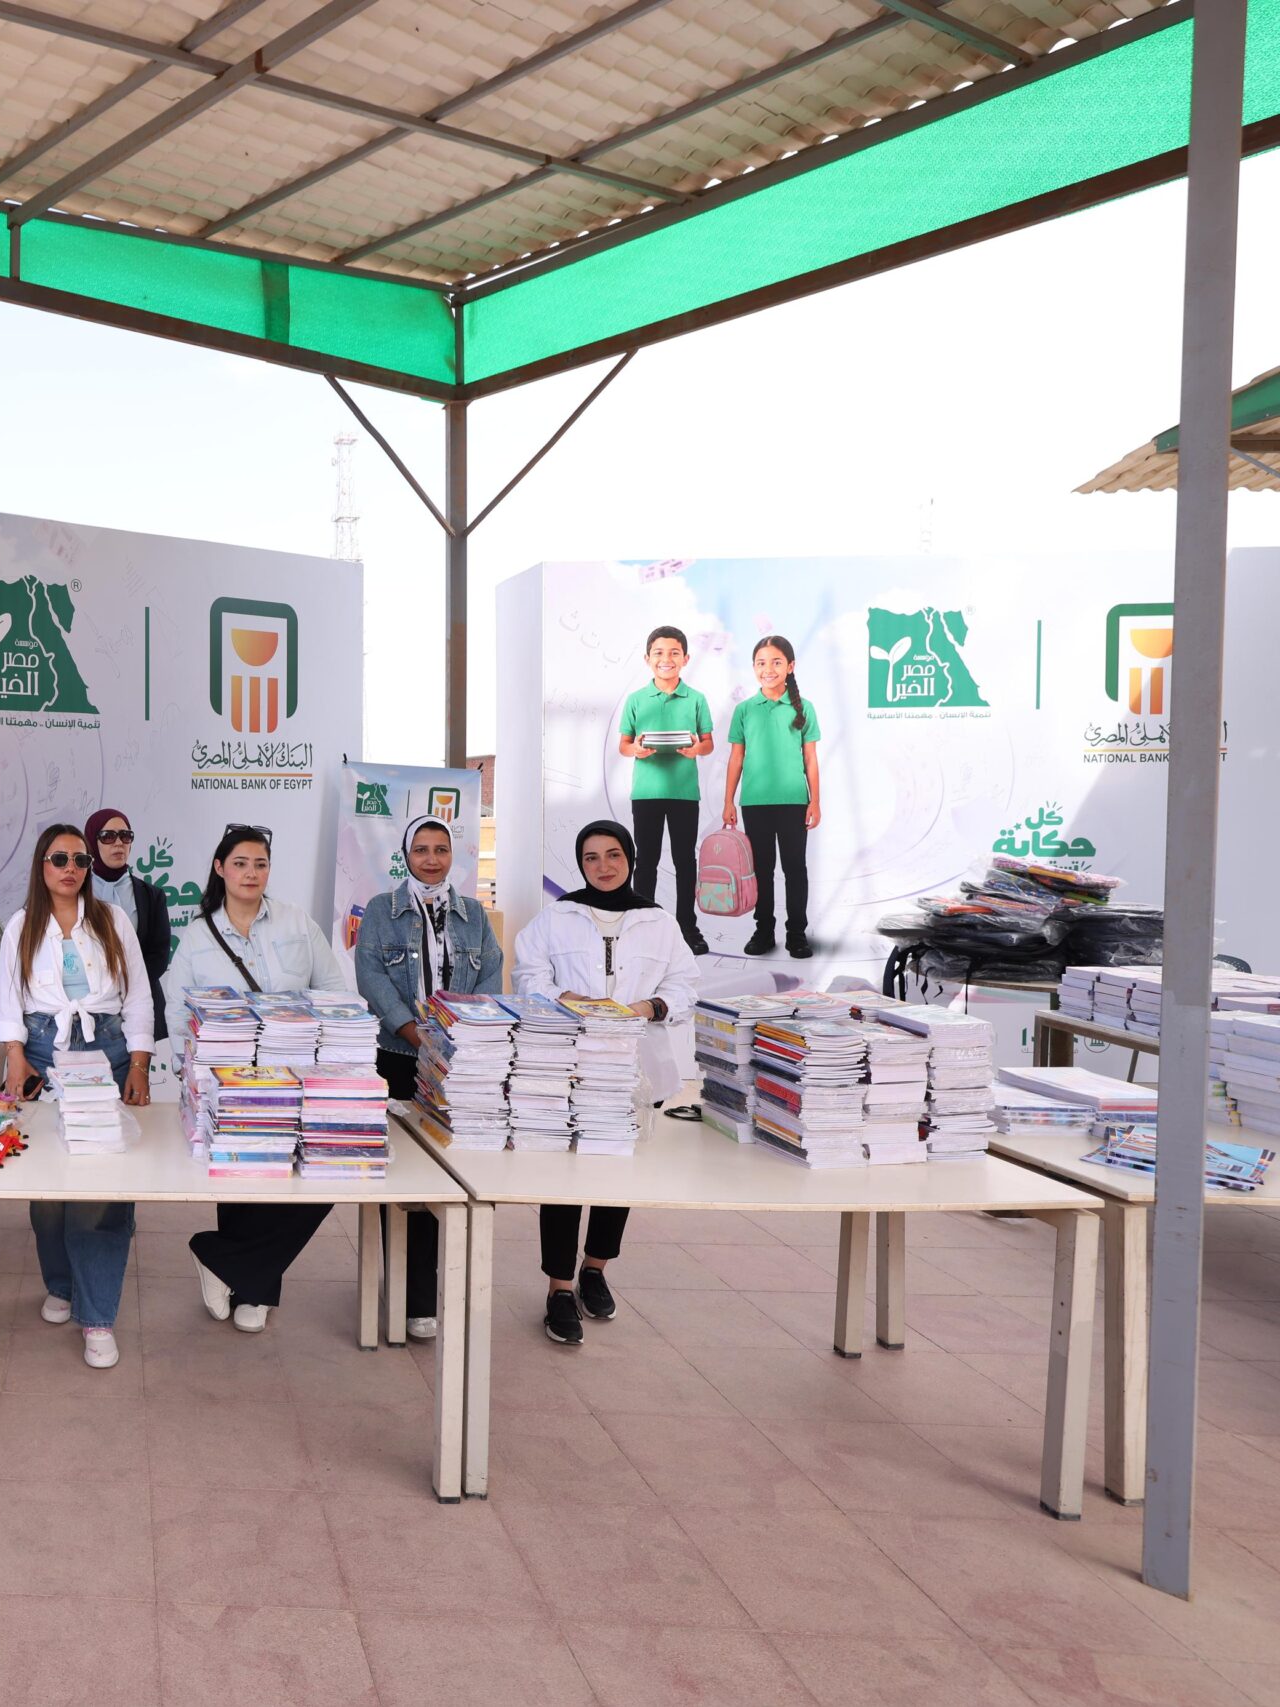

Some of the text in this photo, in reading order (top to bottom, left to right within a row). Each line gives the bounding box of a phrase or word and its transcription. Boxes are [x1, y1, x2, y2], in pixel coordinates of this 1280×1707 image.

[1, 651, 39, 673] مصر
[901, 664, 935, 681] مصر
[892, 677, 935, 702] الخير
[5, 715, 38, 727] مهمتنا
[77, 718, 100, 730] تنمية
[1084, 753, 1170, 763] NATIONAL BANK
[191, 778, 312, 790] NATIONAL BANK OF EGYPT
[1025, 807, 1064, 830] كل
[136, 845, 174, 874] كل
